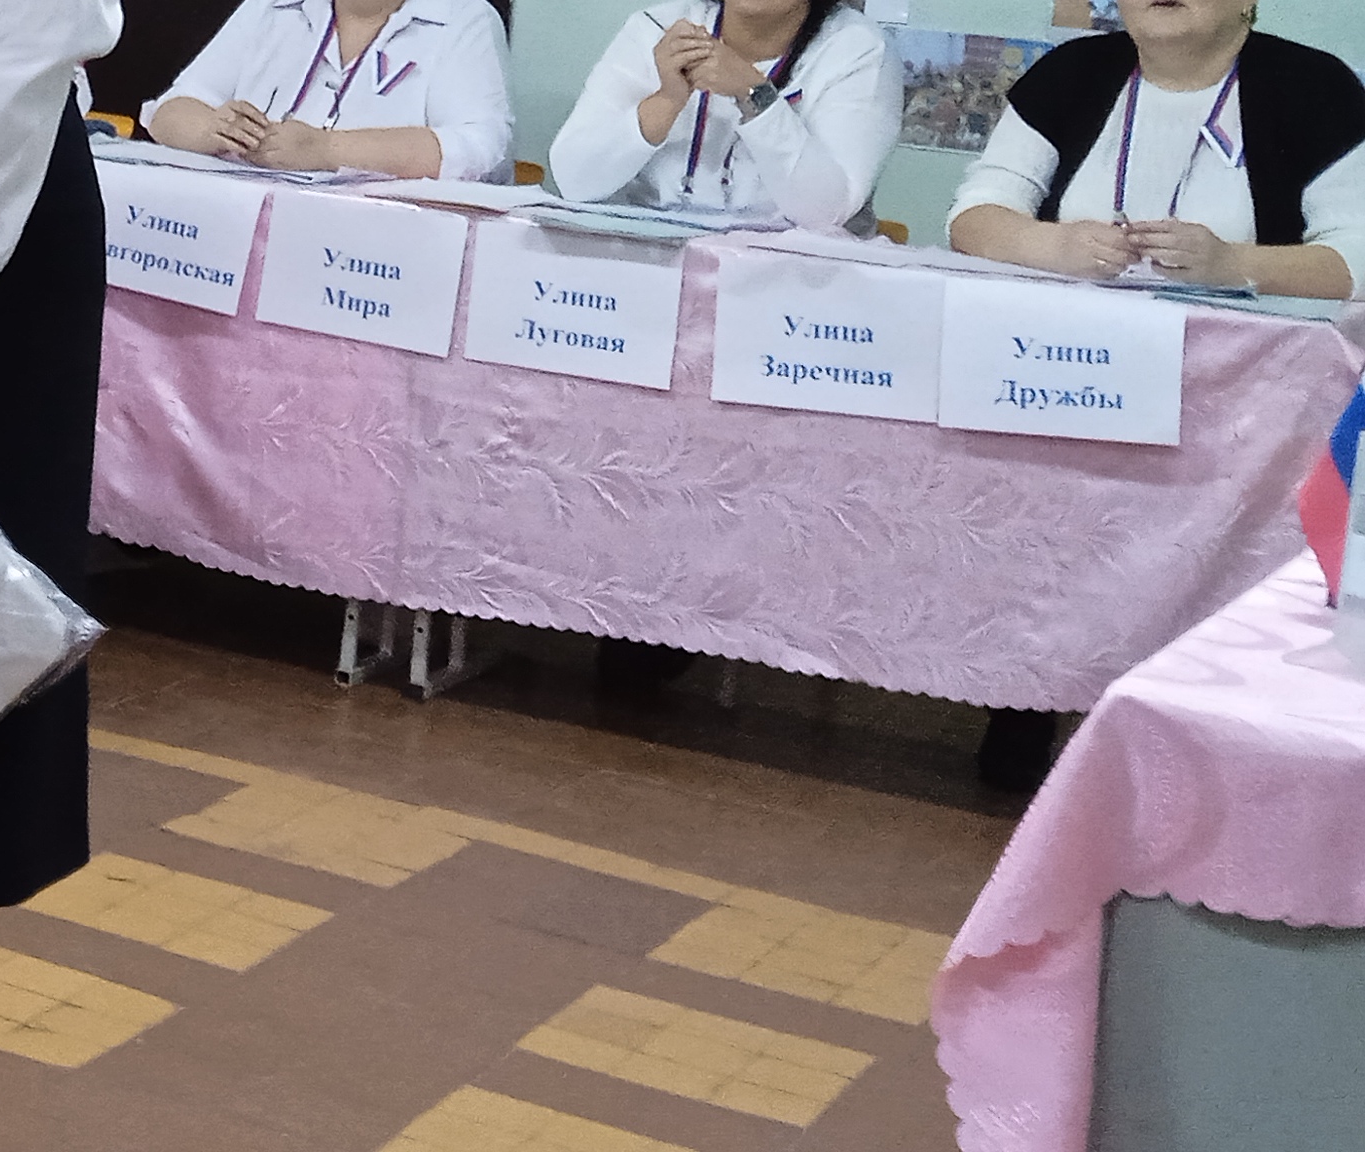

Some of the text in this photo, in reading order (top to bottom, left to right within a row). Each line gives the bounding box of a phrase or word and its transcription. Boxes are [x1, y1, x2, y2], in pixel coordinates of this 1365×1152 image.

[125, 204, 200, 240] Улица
[106, 243, 235, 288] вгородская
[323, 247, 402, 281] Улица
[322, 286, 391, 320] Мира
[534, 280, 616, 311] Улица
[514, 318, 626, 353] Луговая
[782, 314, 875, 344] Улица
[1012, 336, 1111, 365] Улица
[760, 354, 894, 389] Заречная
[995, 379, 1123, 410] Дружбы
